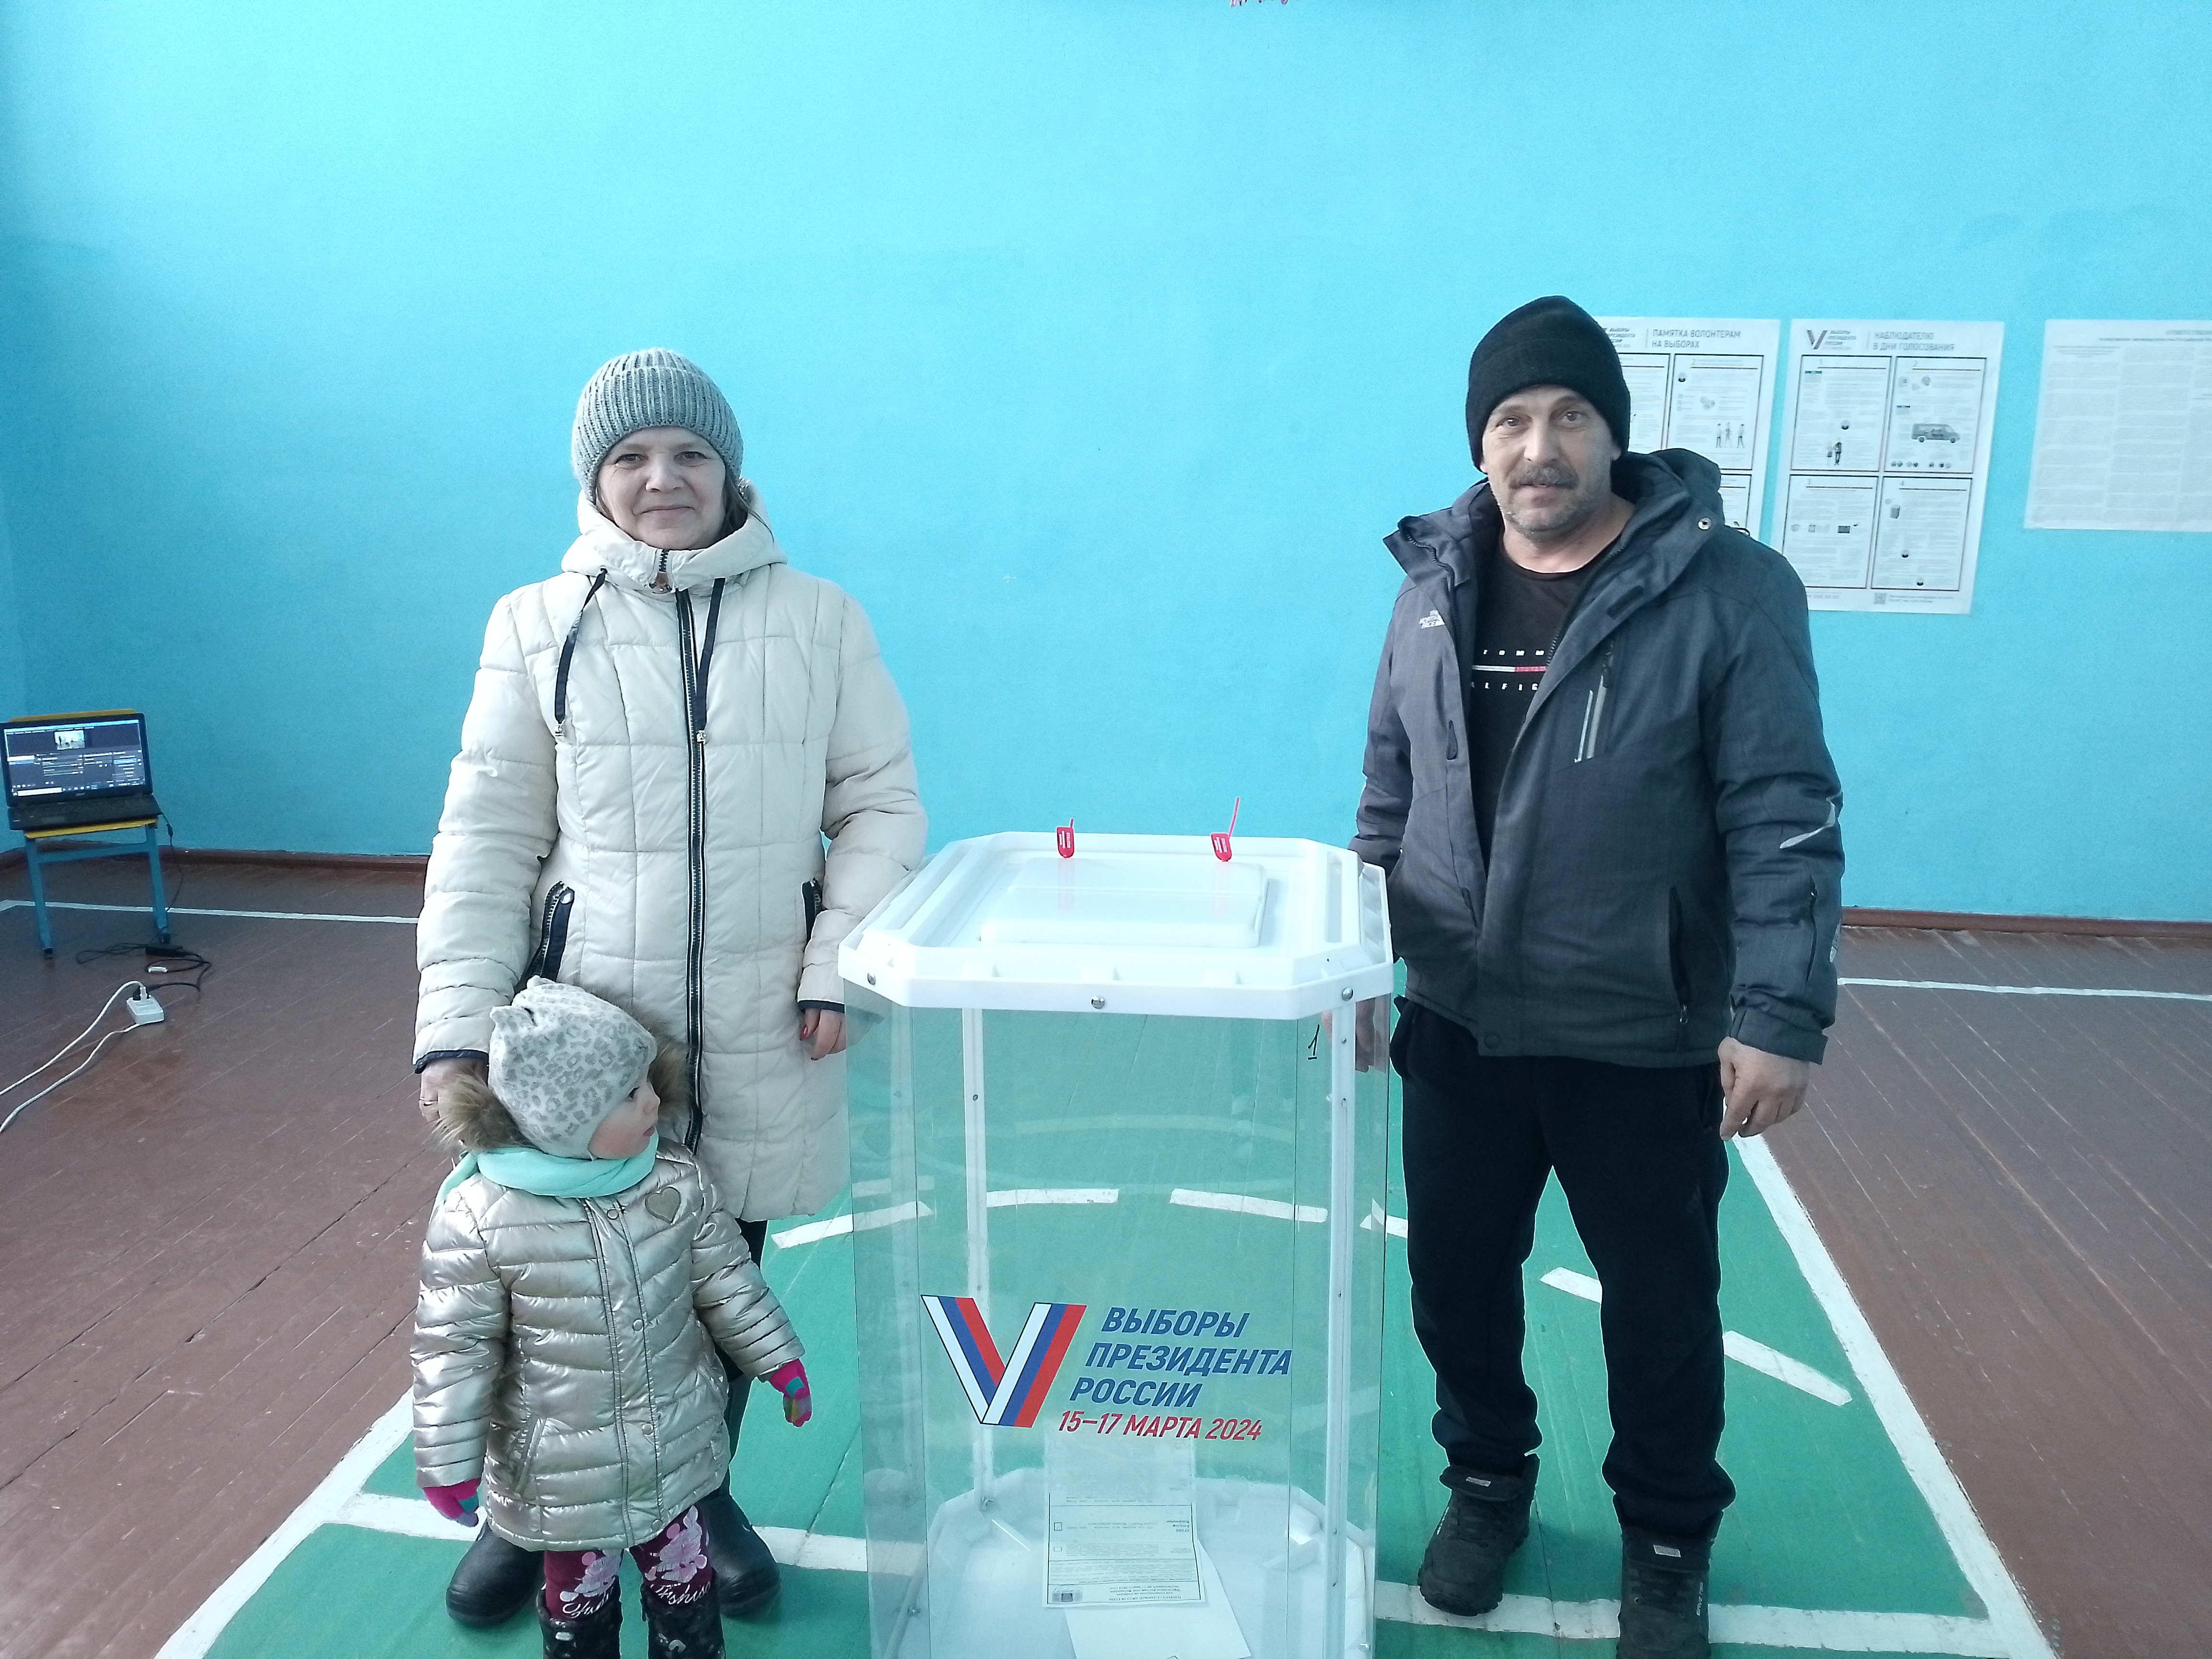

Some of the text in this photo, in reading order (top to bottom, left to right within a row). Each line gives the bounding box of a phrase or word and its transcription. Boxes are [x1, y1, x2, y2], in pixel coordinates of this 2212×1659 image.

[1652, 329, 1741, 338] ПАМЯТКА ВОЛОНТЕРАМ
[1874, 332, 1934, 340] НАБЛЮДАТЕЛЮ
[1663, 340, 1700, 348] ВЫБОРАХ
[1873, 342, 1955, 351] В ДНИ ГОЛОСОВАНИЯ
[1471, 681, 1539, 692] ILFIG
[1102, 1307, 1250, 1338] ВЫБОРЫ
[1085, 1342, 1292, 1377] ПРЕЗИДЕНТА
[1070, 1377, 1202, 1408] РОССИИ
[1123, 1413, 1202, 1439] МАРТА
[1205, 1418, 1262, 1441] 2024
